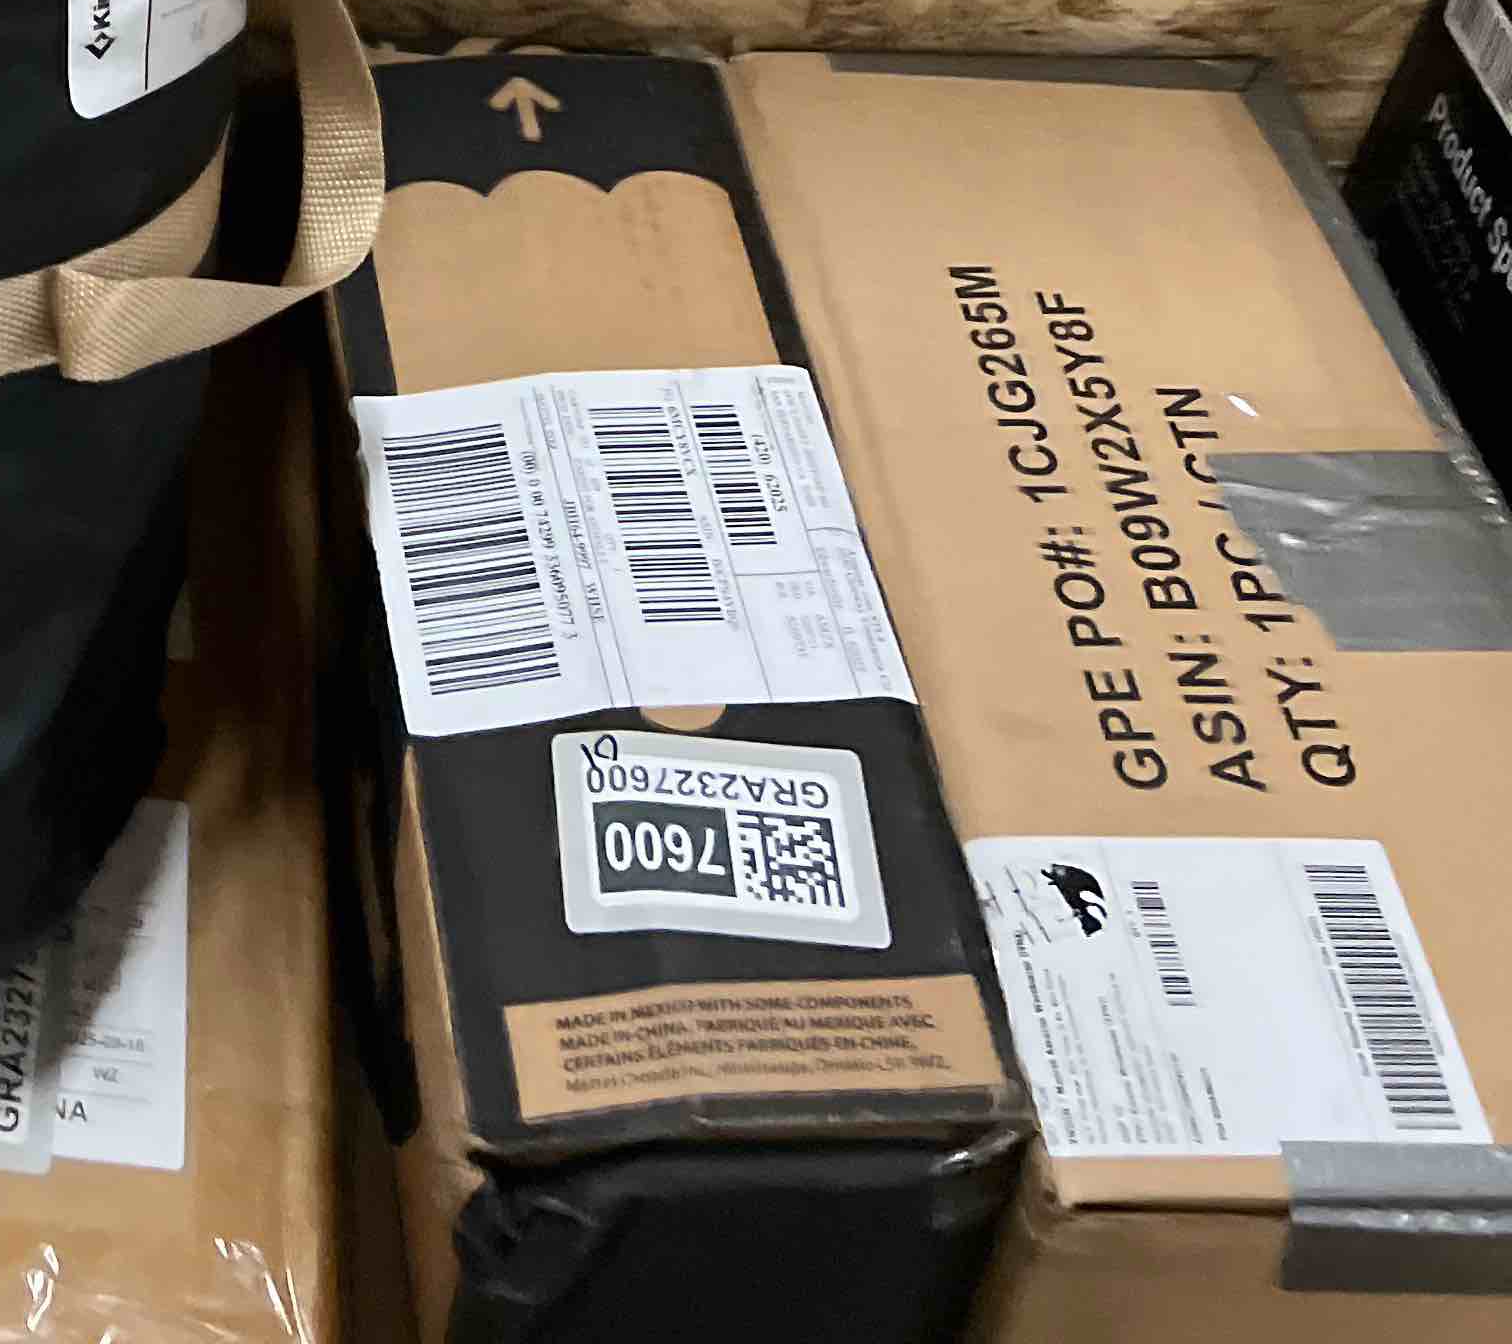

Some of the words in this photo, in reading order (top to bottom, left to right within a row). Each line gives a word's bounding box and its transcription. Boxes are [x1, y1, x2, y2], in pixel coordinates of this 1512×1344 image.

[1428, 92, 1493, 227] Product
[947, 264, 1074, 505] 1CJG265M
[1156, 386, 1220, 487] CTN
[751, 433, 771, 465] (420)
[1035, 290, 1199, 612] B09W2X5Y8F
[1040, 525, 1123, 648] PO#:
[1213, 532, 1296, 634] 1PC
[1084, 669, 1168, 791] GPE
[1167, 634, 1268, 792] ASIN:
[1265, 656, 1357, 788] QTY:
[586, 764, 830, 810] GRA2327600
[604, 821, 726, 877] 7600
